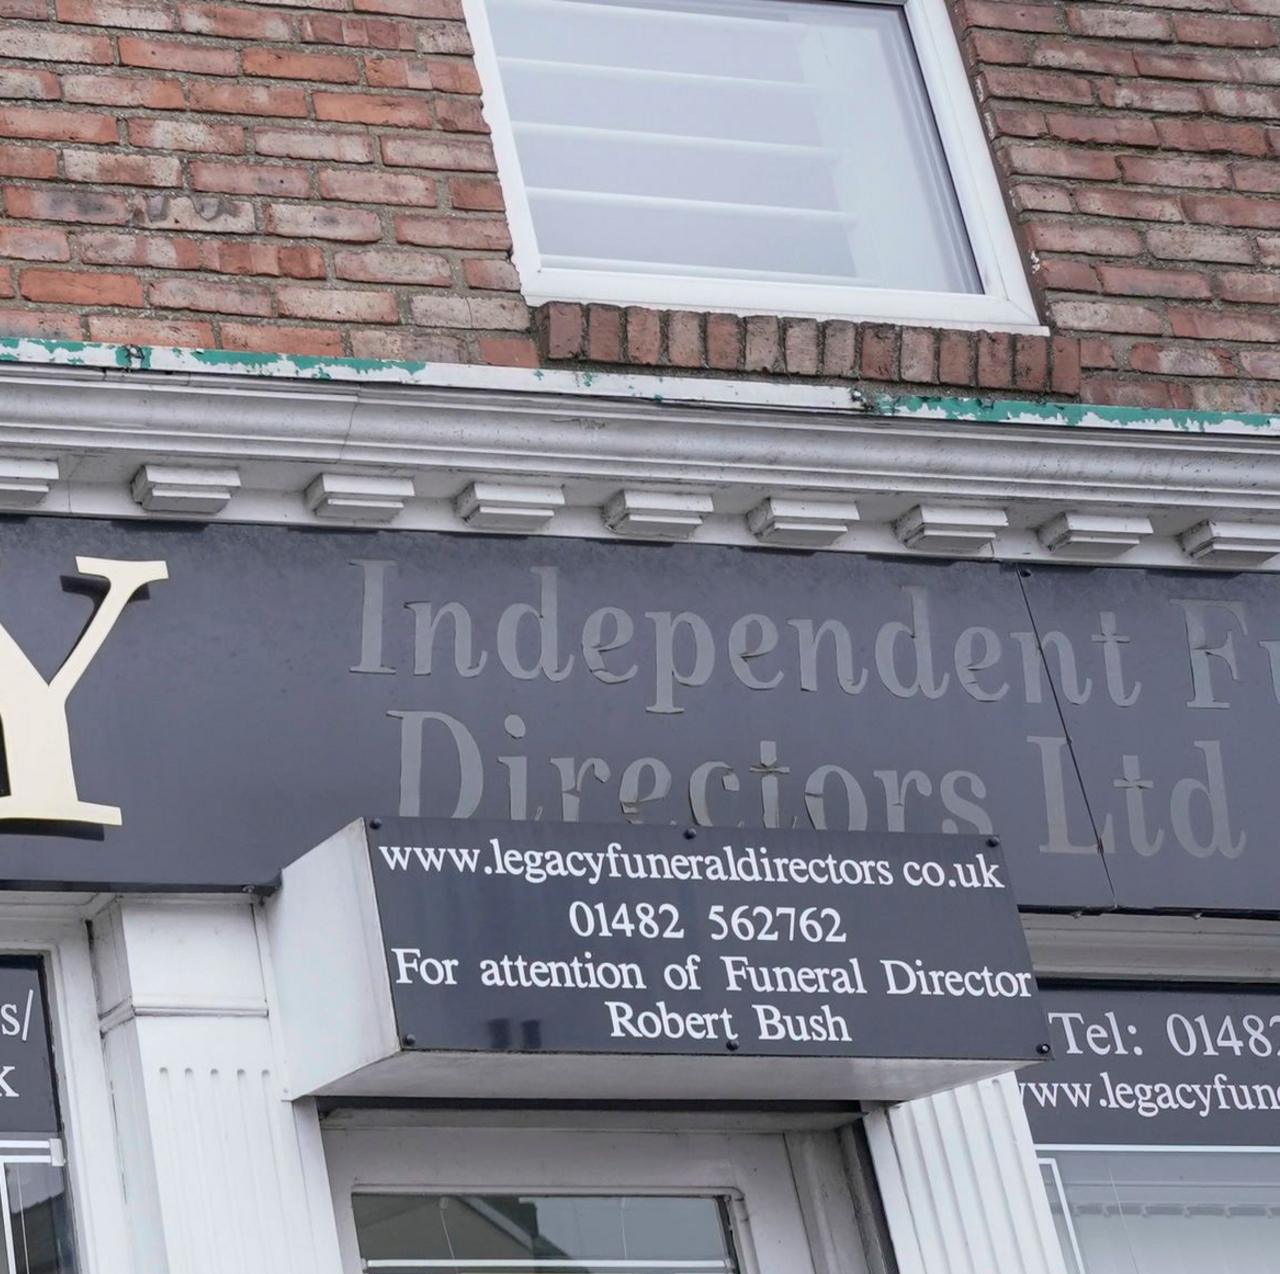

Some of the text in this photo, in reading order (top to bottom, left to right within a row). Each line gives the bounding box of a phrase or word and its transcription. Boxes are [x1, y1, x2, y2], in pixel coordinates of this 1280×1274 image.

[348, 558, 1142, 715] Independent
[385, 709, 1246, 859] Directors Ltd
[378, 838, 1004, 889] www.legacyfuneraldirectors co.uk
[568, 901, 848, 943] 01482 562762
[391, 948, 1032, 998] For attention of Funeral Director
[605, 1000, 852, 1042] Robert Bush
[1047, 1011, 1143, 1056] Tel:
